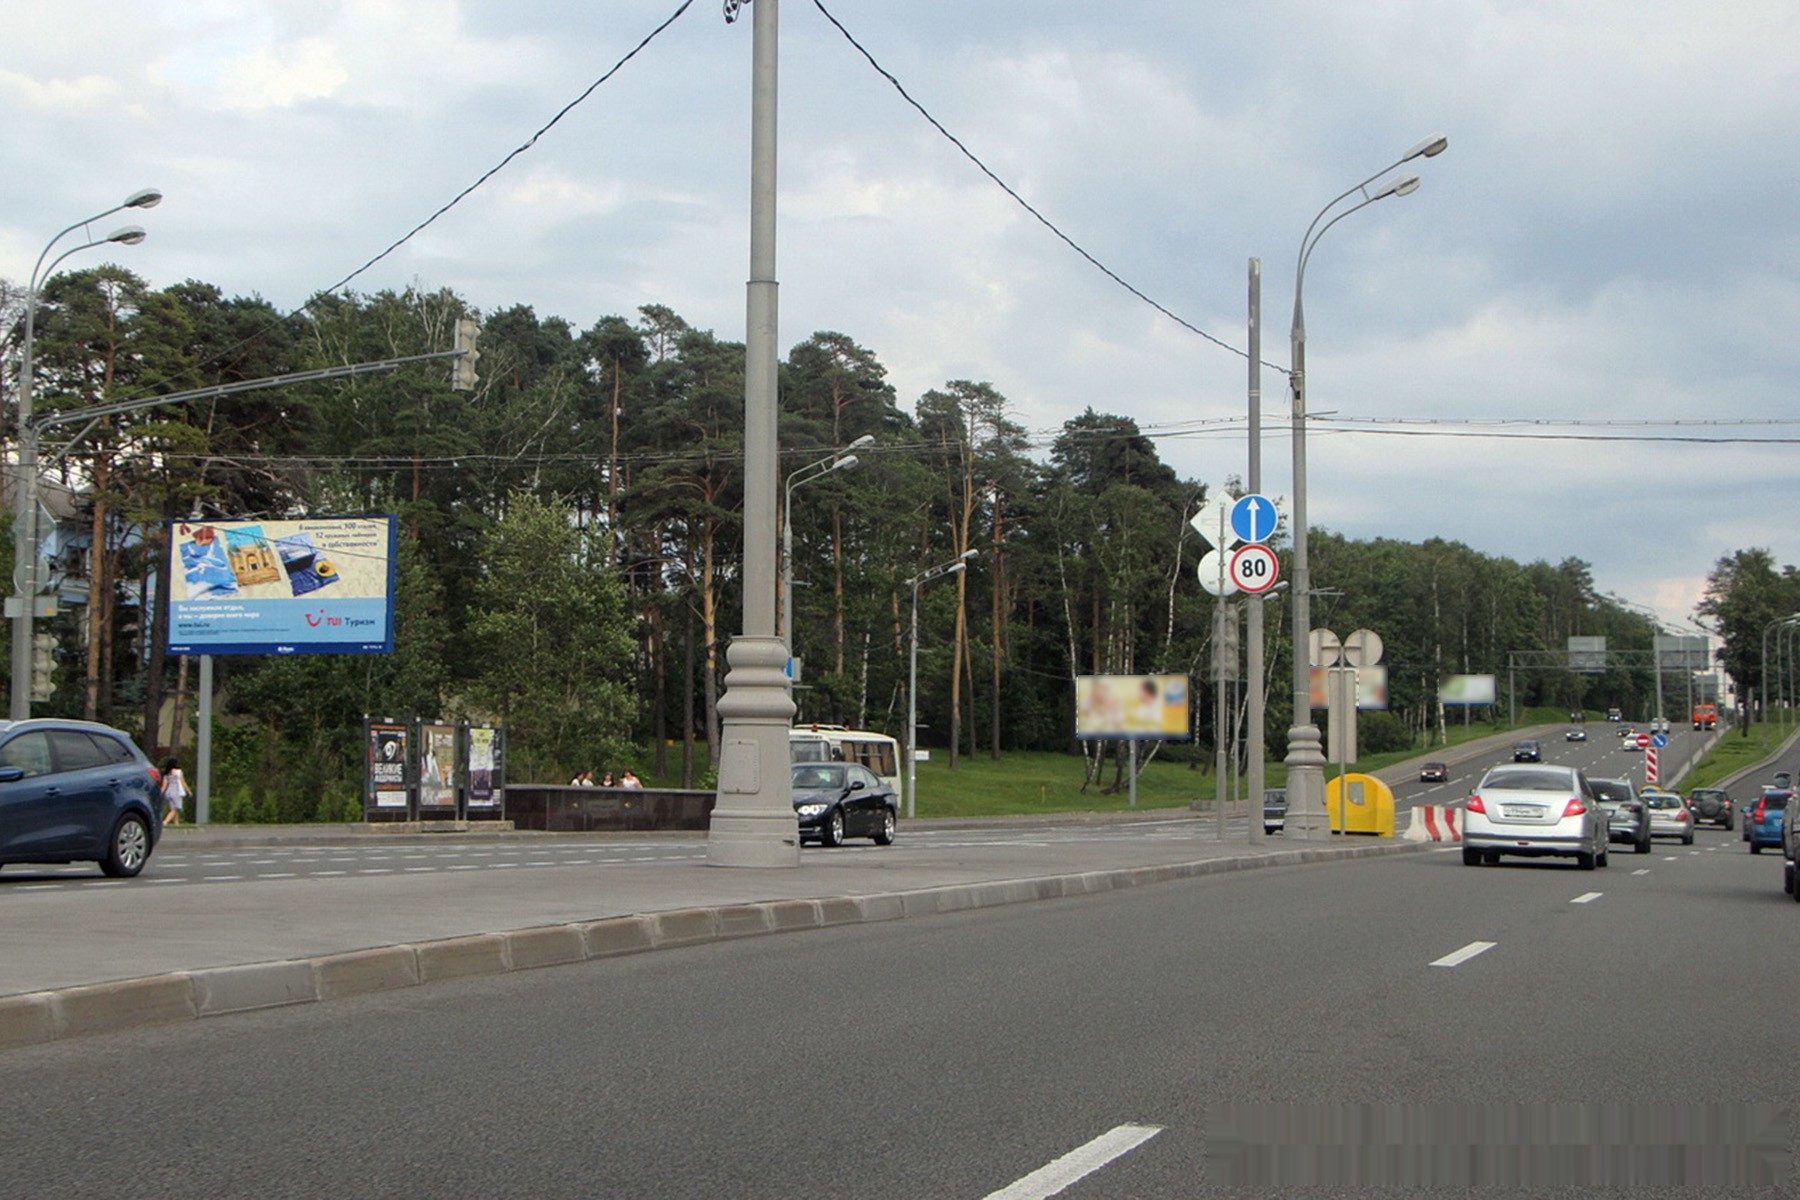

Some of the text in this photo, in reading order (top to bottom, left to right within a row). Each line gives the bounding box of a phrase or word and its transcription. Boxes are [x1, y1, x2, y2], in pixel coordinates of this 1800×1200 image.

[1242, 558, 1266, 577] 80
[327, 617, 375, 627] TUI Туризм
